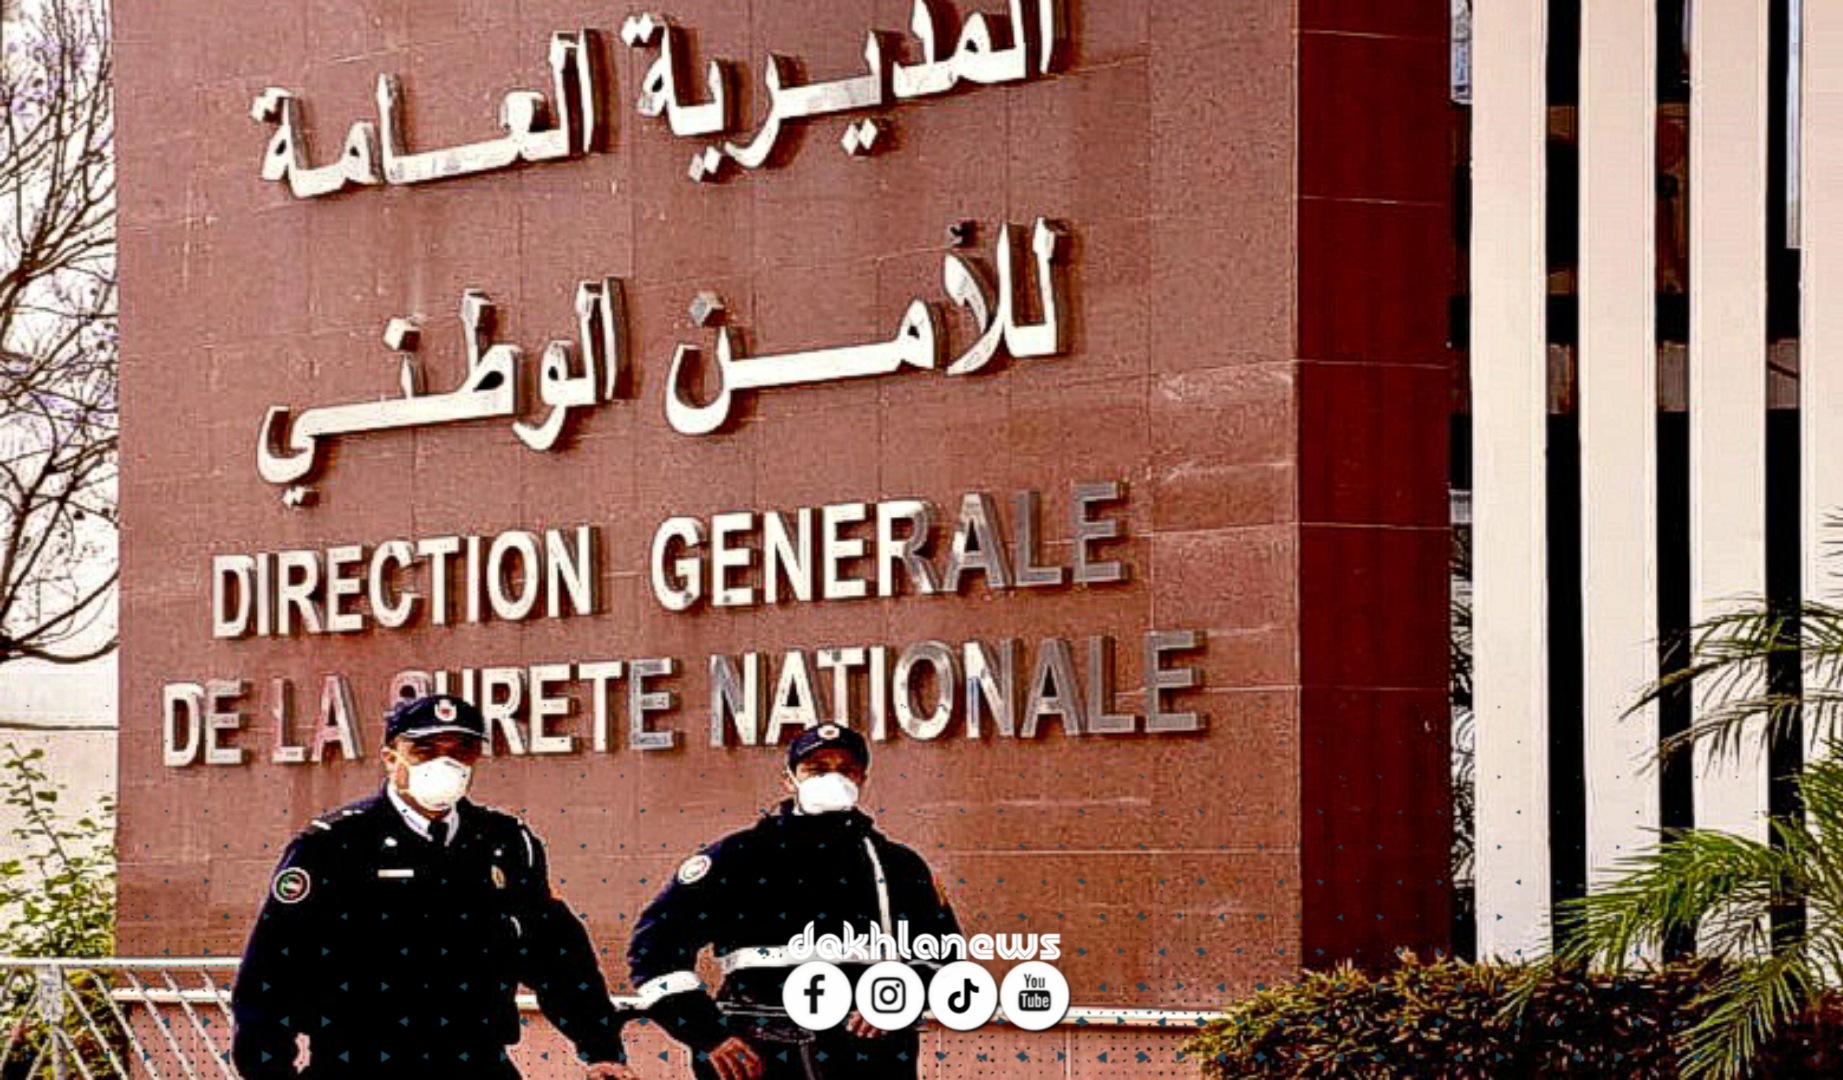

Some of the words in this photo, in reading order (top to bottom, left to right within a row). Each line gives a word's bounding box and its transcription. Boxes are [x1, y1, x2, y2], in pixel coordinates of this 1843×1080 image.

[250, 26, 602, 198] العامة
[621, 0, 1060, 182] المديرية
[255, 276, 627, 507] الوطني
[663, 216, 1068, 435] للأمن
[212, 524, 598, 639] DIRECTION
[650, 481, 1129, 613] GENERALE
[163, 678, 247, 766] DE
[270, 673, 363, 763] LA
[709, 630, 1206, 747] NATIONALE
